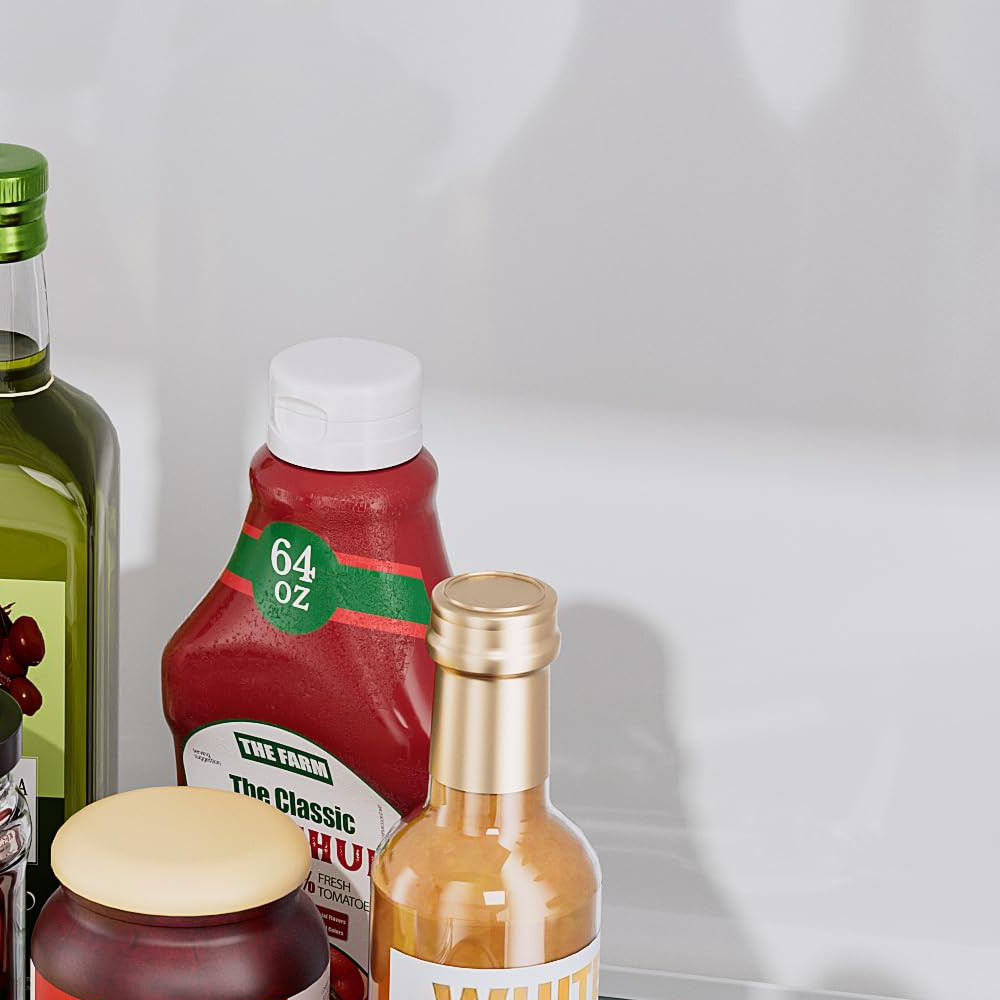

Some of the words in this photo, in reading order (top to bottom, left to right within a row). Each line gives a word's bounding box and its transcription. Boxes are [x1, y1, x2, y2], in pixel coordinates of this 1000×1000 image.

[271, 538, 316, 583] 64
[239, 738, 276, 762] THE
[276, 744, 328, 779] FARM
[229, 774, 270, 804] The
[274, 788, 356, 834] Classic
[318, 873, 350, 892] FRESH
[318, 886, 370, 912] TOMATOE
